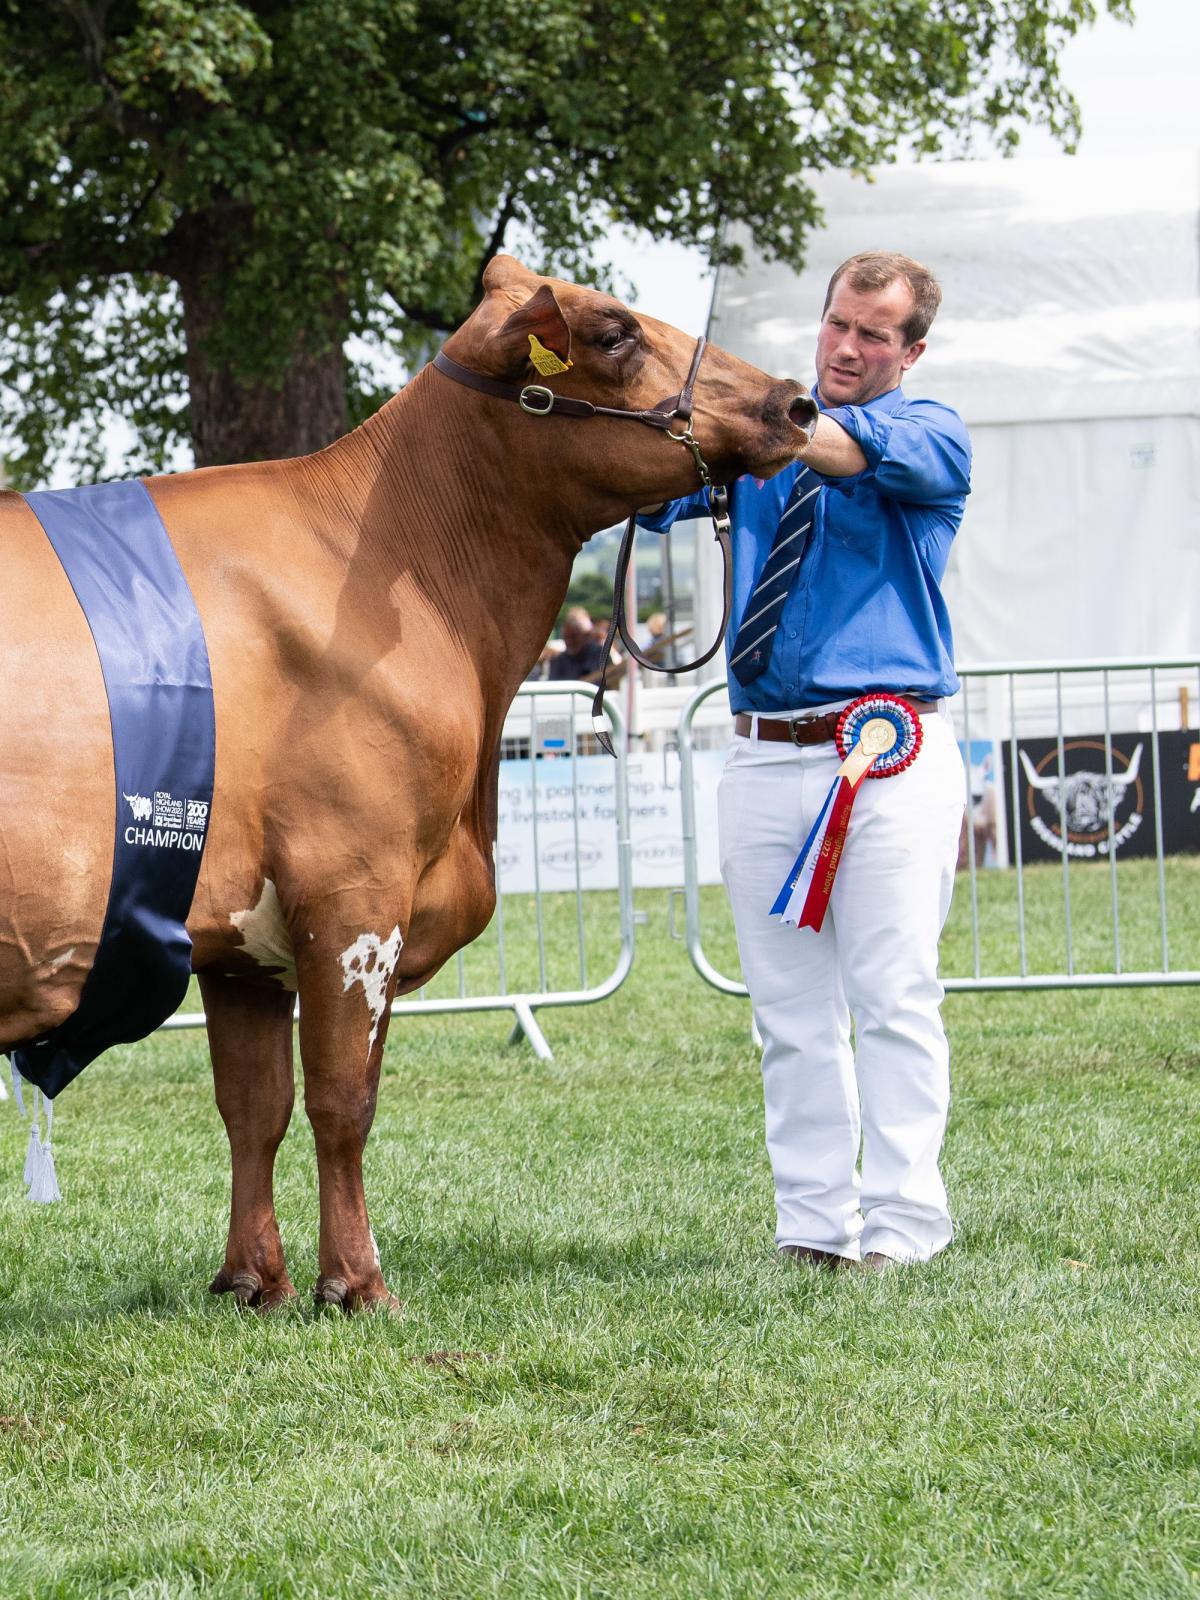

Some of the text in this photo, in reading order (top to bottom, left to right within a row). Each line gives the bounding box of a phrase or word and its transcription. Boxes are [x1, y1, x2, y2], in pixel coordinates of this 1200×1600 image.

[156, 791, 171, 800] ROYAL
[156, 798, 183, 808] HIGHLAND
[187, 803, 208, 818] 200
[186, 816, 206, 826] YEARS
[124, 826, 204, 851] CHAMPION
[821, 835, 833, 857] 2022
[822, 805, 852, 895] Royal Highland Show
